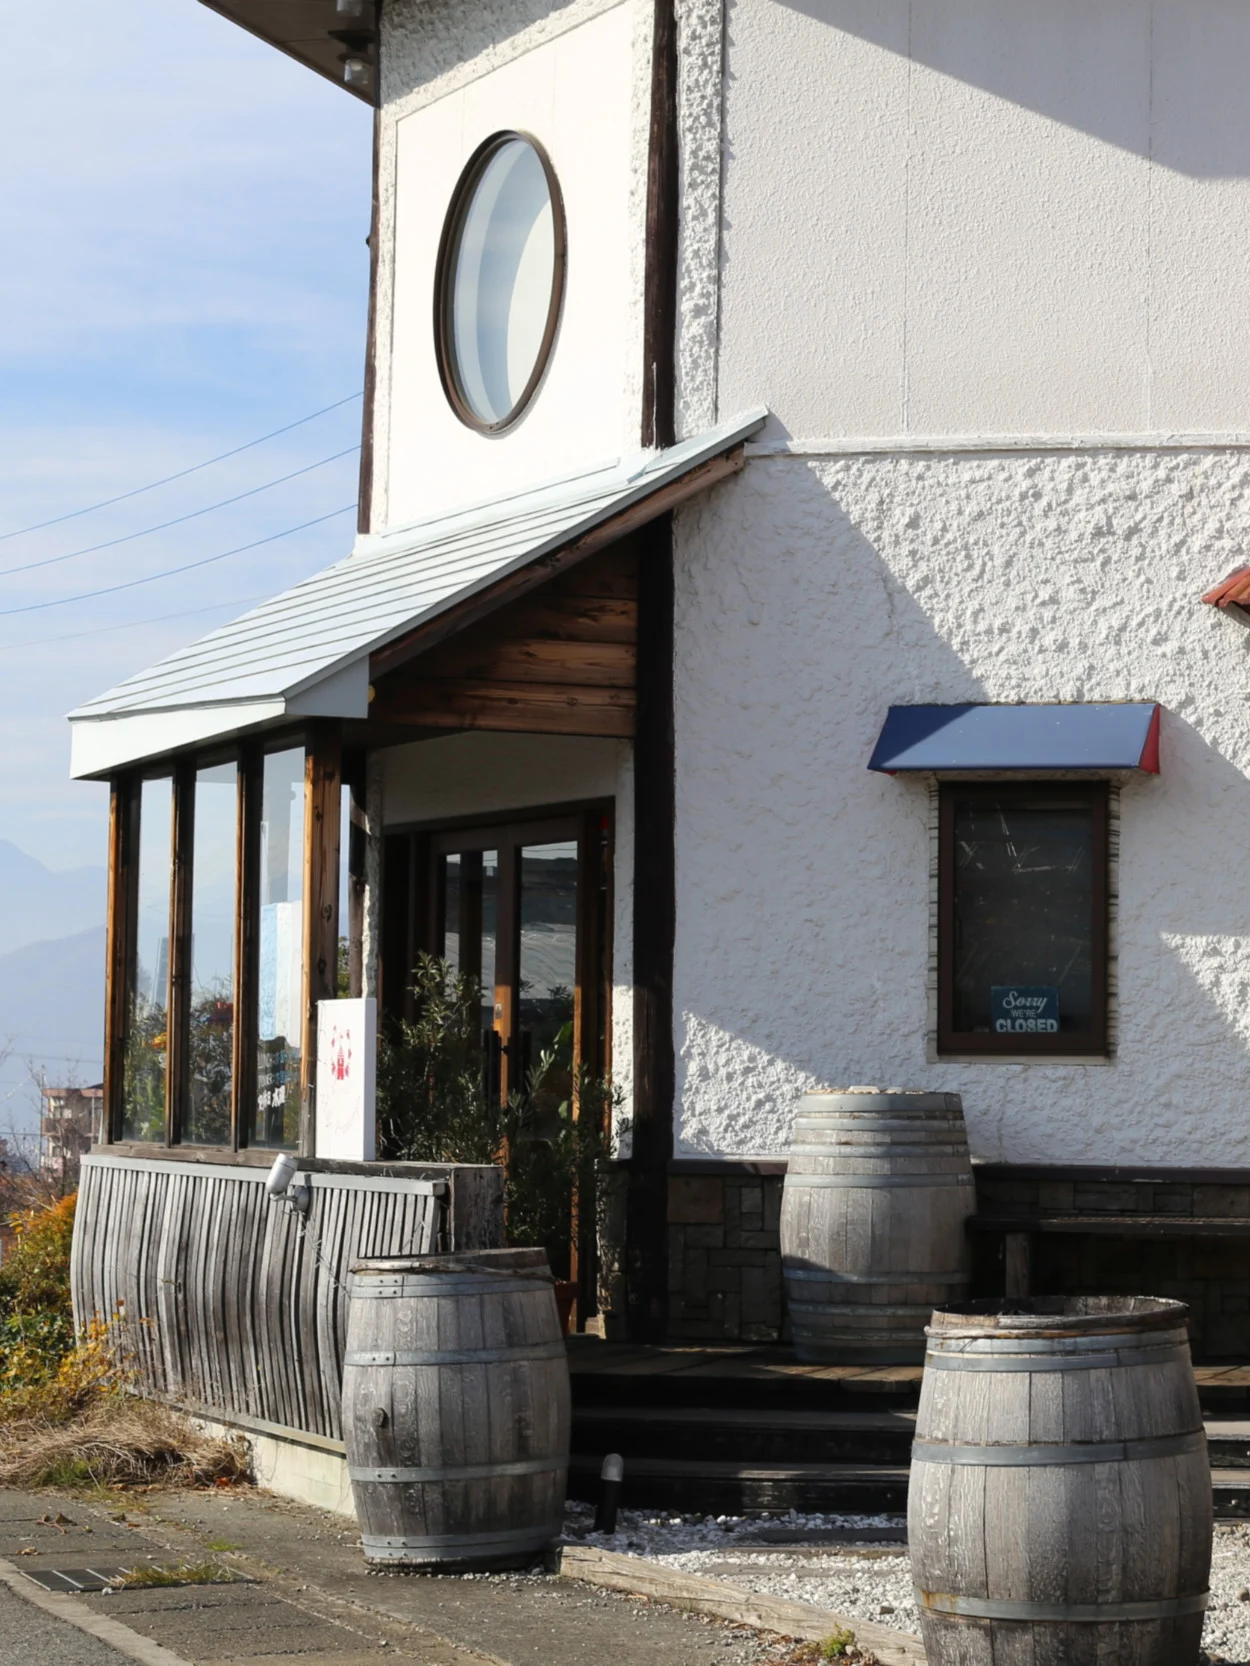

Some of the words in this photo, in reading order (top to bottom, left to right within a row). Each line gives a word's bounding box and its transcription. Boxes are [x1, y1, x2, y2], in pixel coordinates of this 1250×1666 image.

[1003, 991, 1047, 1013] Sorry
[1010, 1009, 1036, 1018] WE'RE
[996, 1019, 1057, 1032] CLOSED
